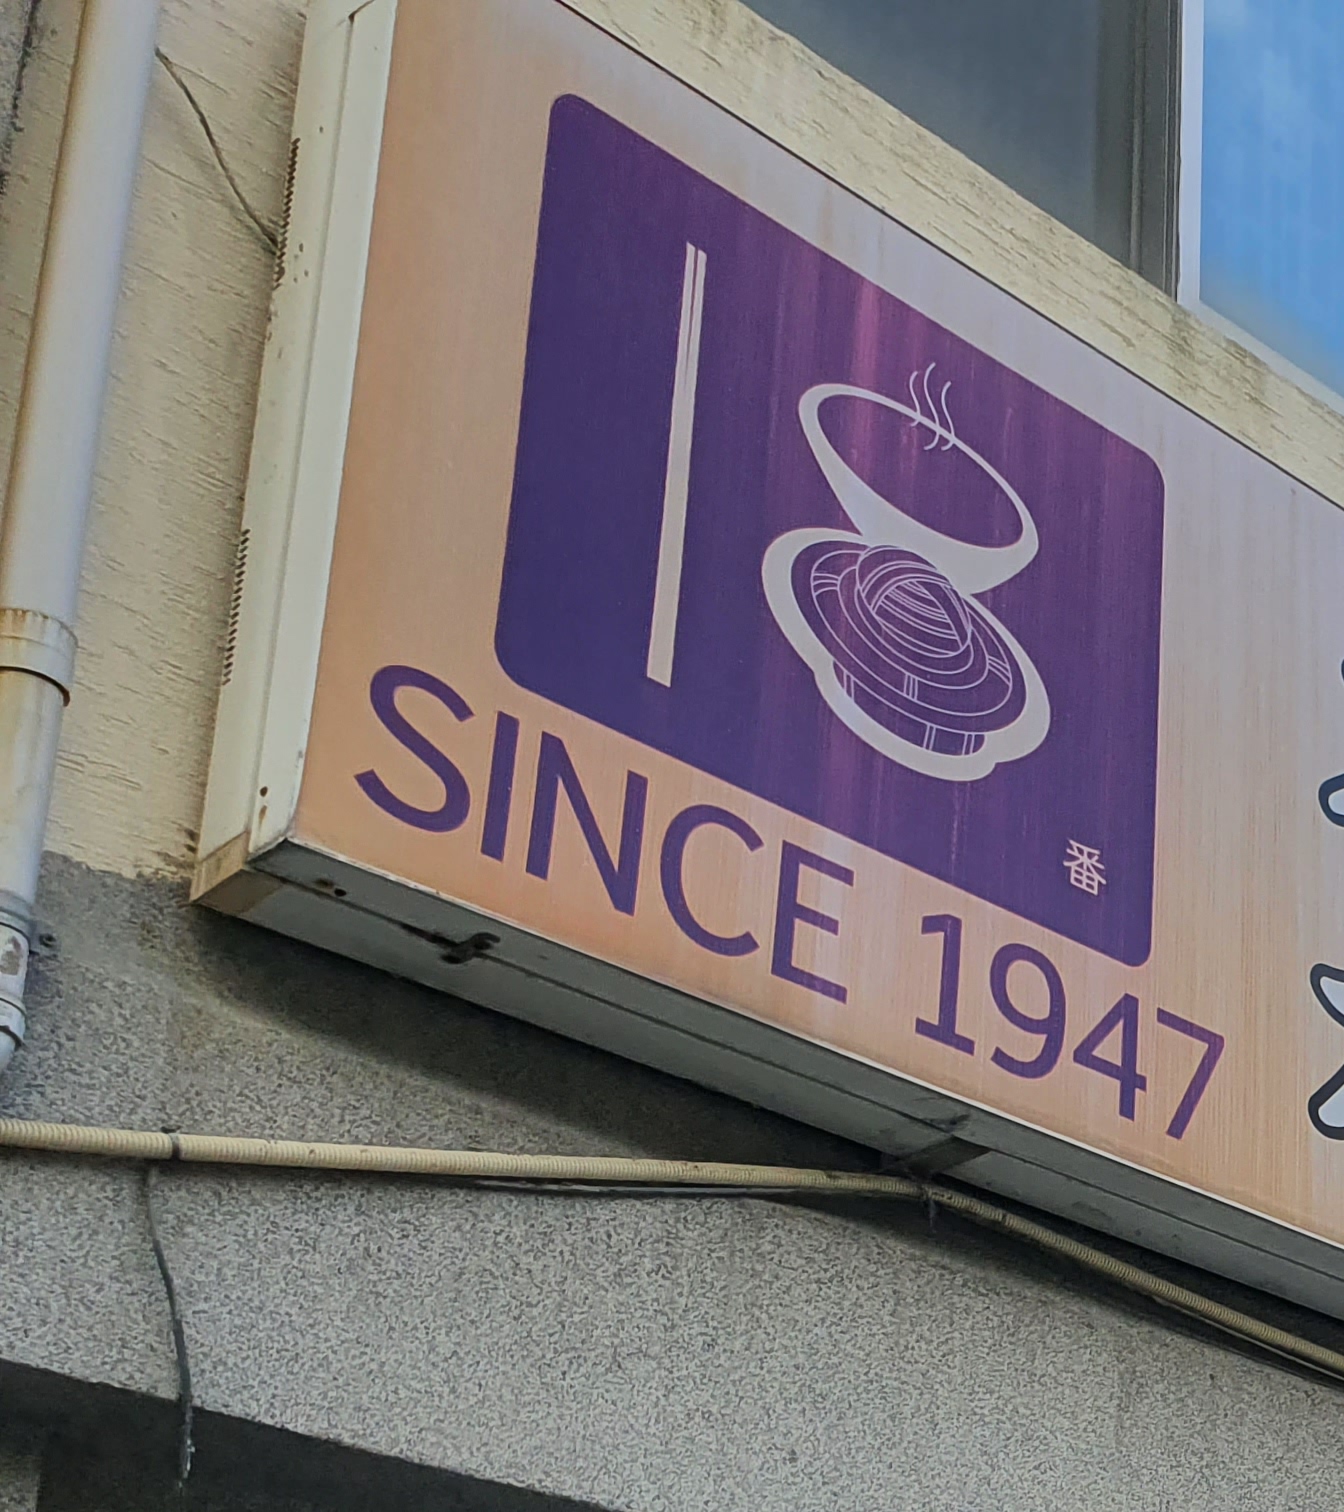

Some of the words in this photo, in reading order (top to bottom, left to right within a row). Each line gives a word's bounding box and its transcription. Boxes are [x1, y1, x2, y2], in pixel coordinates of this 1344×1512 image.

[354, 664, 855, 1007] SINCE
[914, 913, 1225, 1142] 1947
[1061, 838, 1108, 897] 番
